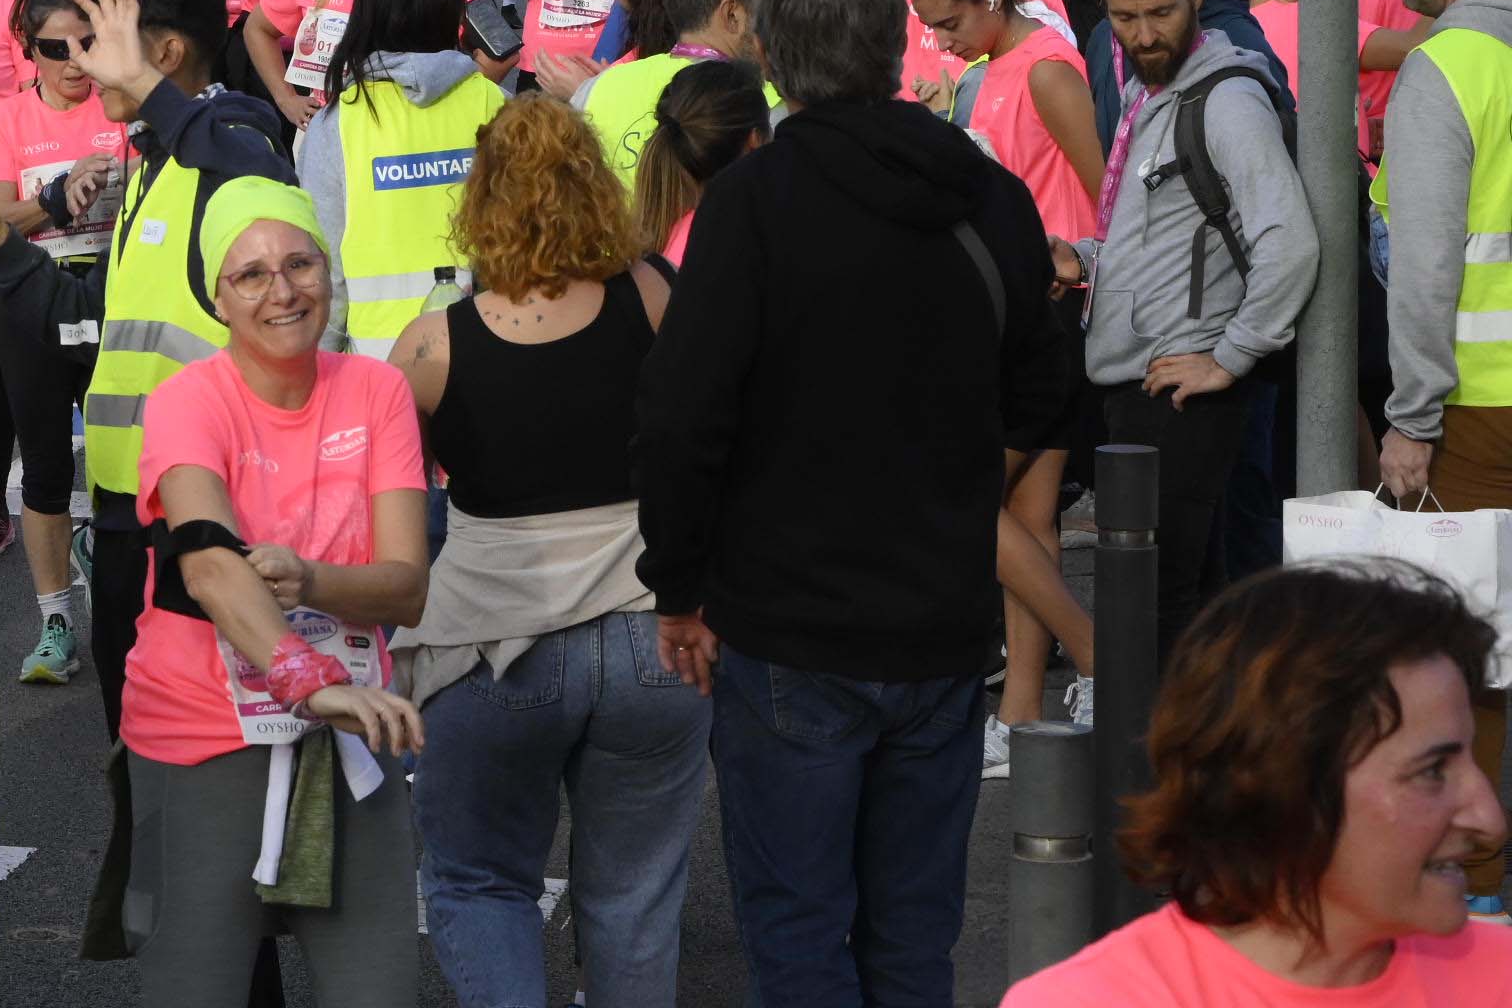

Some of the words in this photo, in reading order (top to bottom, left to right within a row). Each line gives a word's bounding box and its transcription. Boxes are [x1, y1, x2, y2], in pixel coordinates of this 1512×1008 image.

[376, 157, 473, 182] VOLUNTAR
[1299, 514, 1343, 529] OYSHO
[255, 703, 282, 713] CARR
[257, 721, 305, 735] OYSHO
